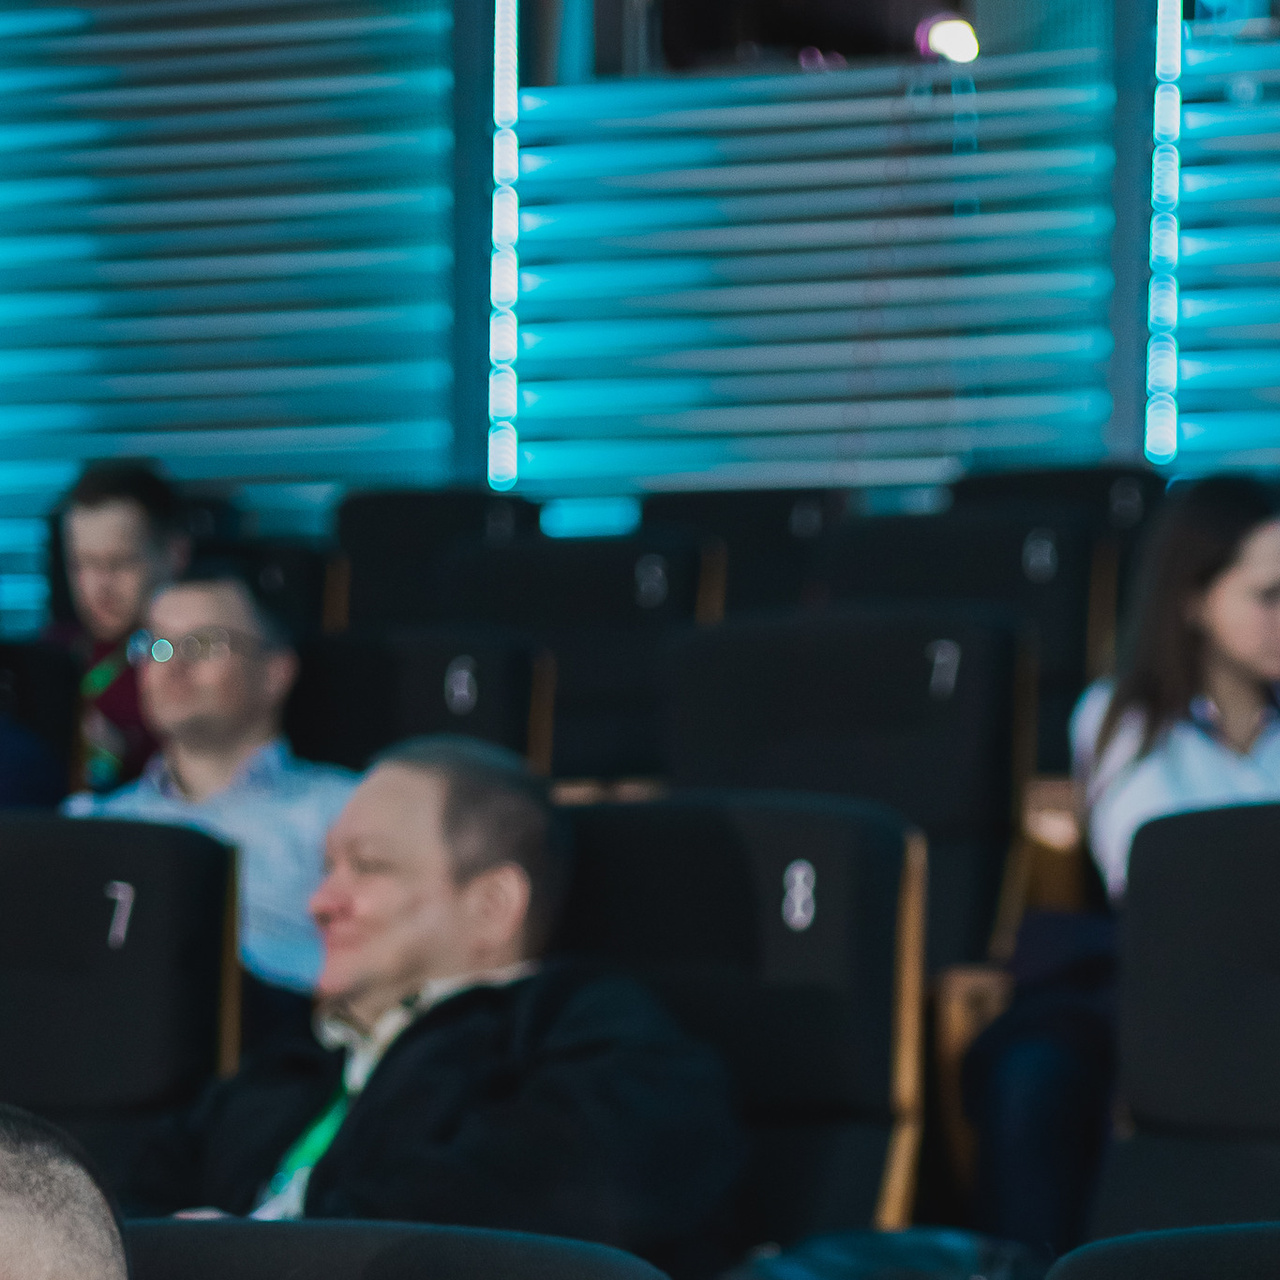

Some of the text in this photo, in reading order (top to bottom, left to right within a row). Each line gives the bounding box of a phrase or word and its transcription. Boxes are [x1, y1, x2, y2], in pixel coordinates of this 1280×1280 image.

[926, 639, 961, 698] 7
[106, 880, 135, 948] 7
[782, 858, 816, 931] 8
